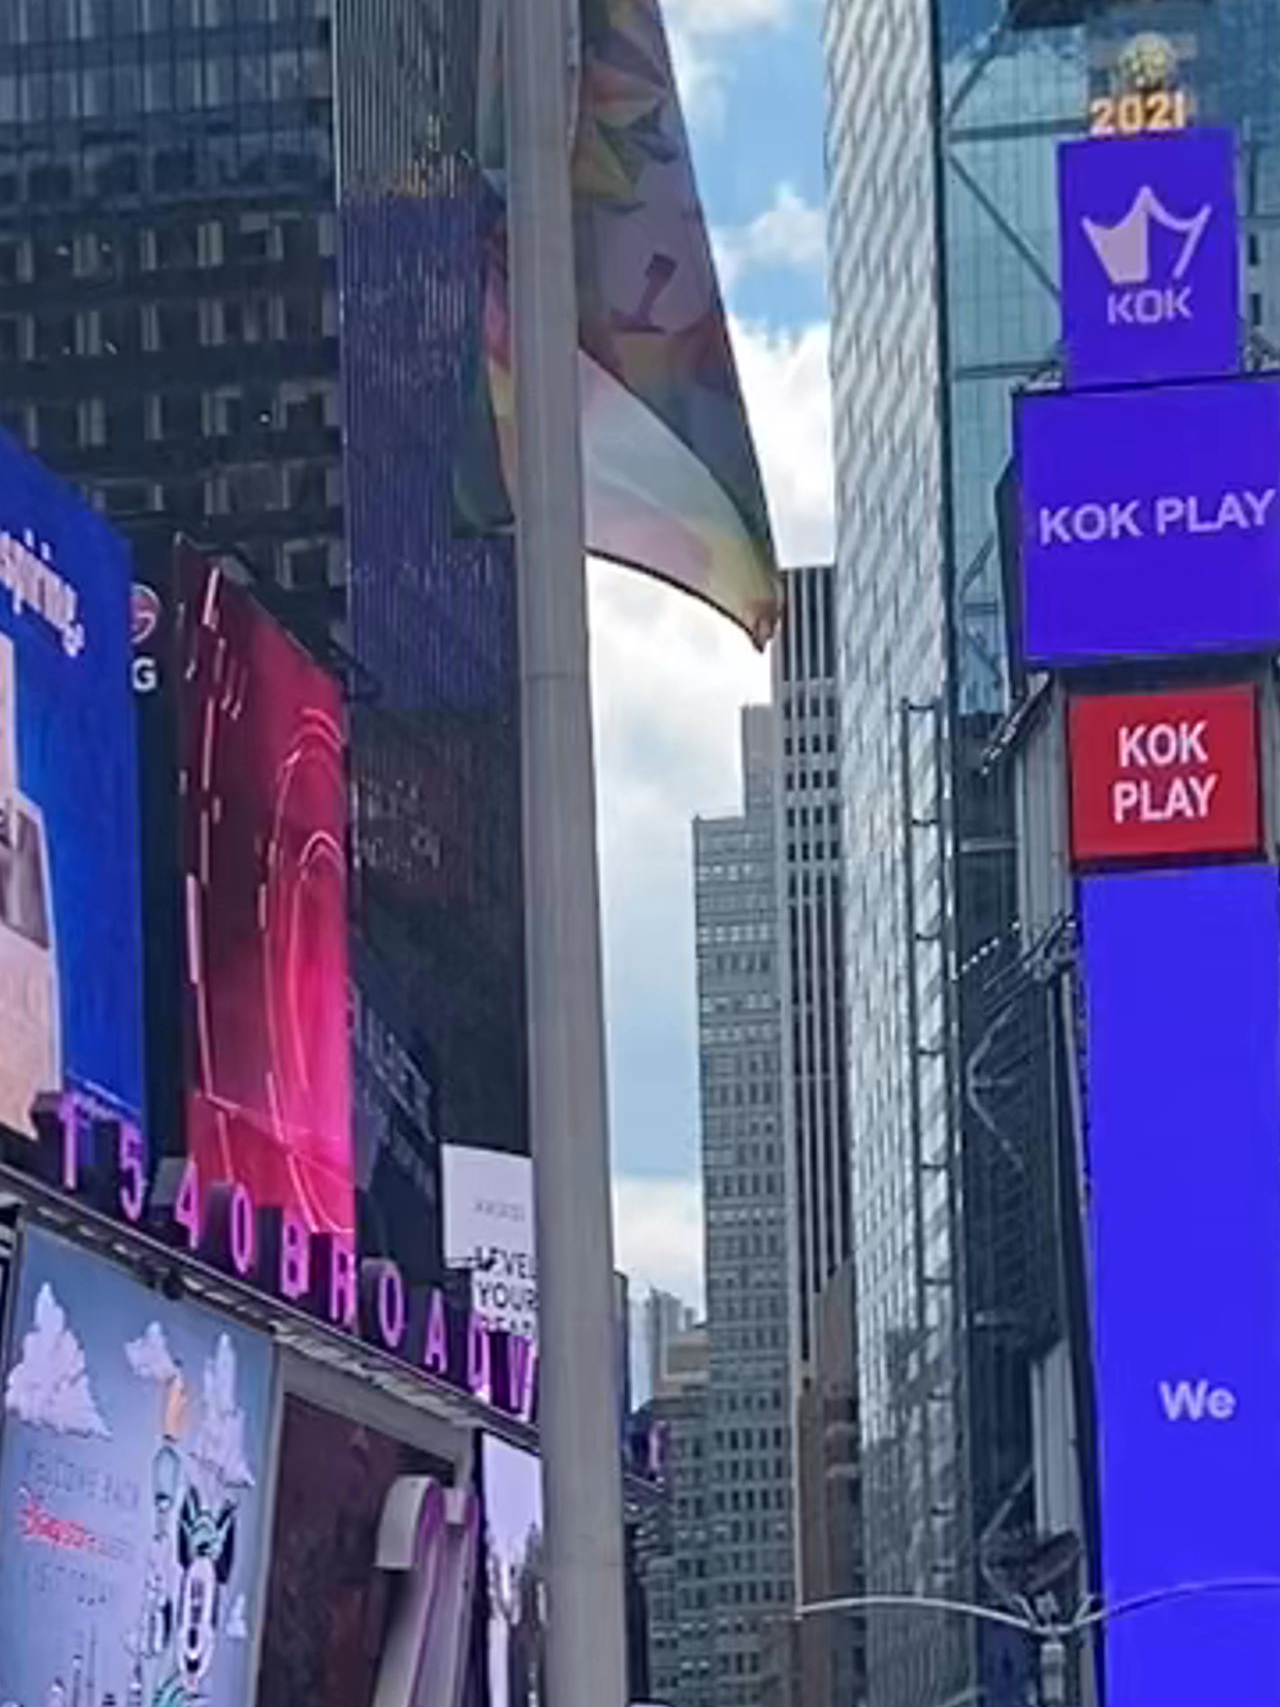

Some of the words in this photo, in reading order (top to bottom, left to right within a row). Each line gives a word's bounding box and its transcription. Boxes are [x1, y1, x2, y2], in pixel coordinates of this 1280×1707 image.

[1089, 90, 1188, 134] 2021
[1107, 287, 1193, 324] KOK
[1038, 499, 1143, 546] KOK
[1155, 488, 1276, 534] PLAY
[130, 657, 157, 691] G
[1117, 719, 1209, 768] KOK
[1113, 773, 1219, 824] PLAY
[1160, 1379, 1236, 1422] We
